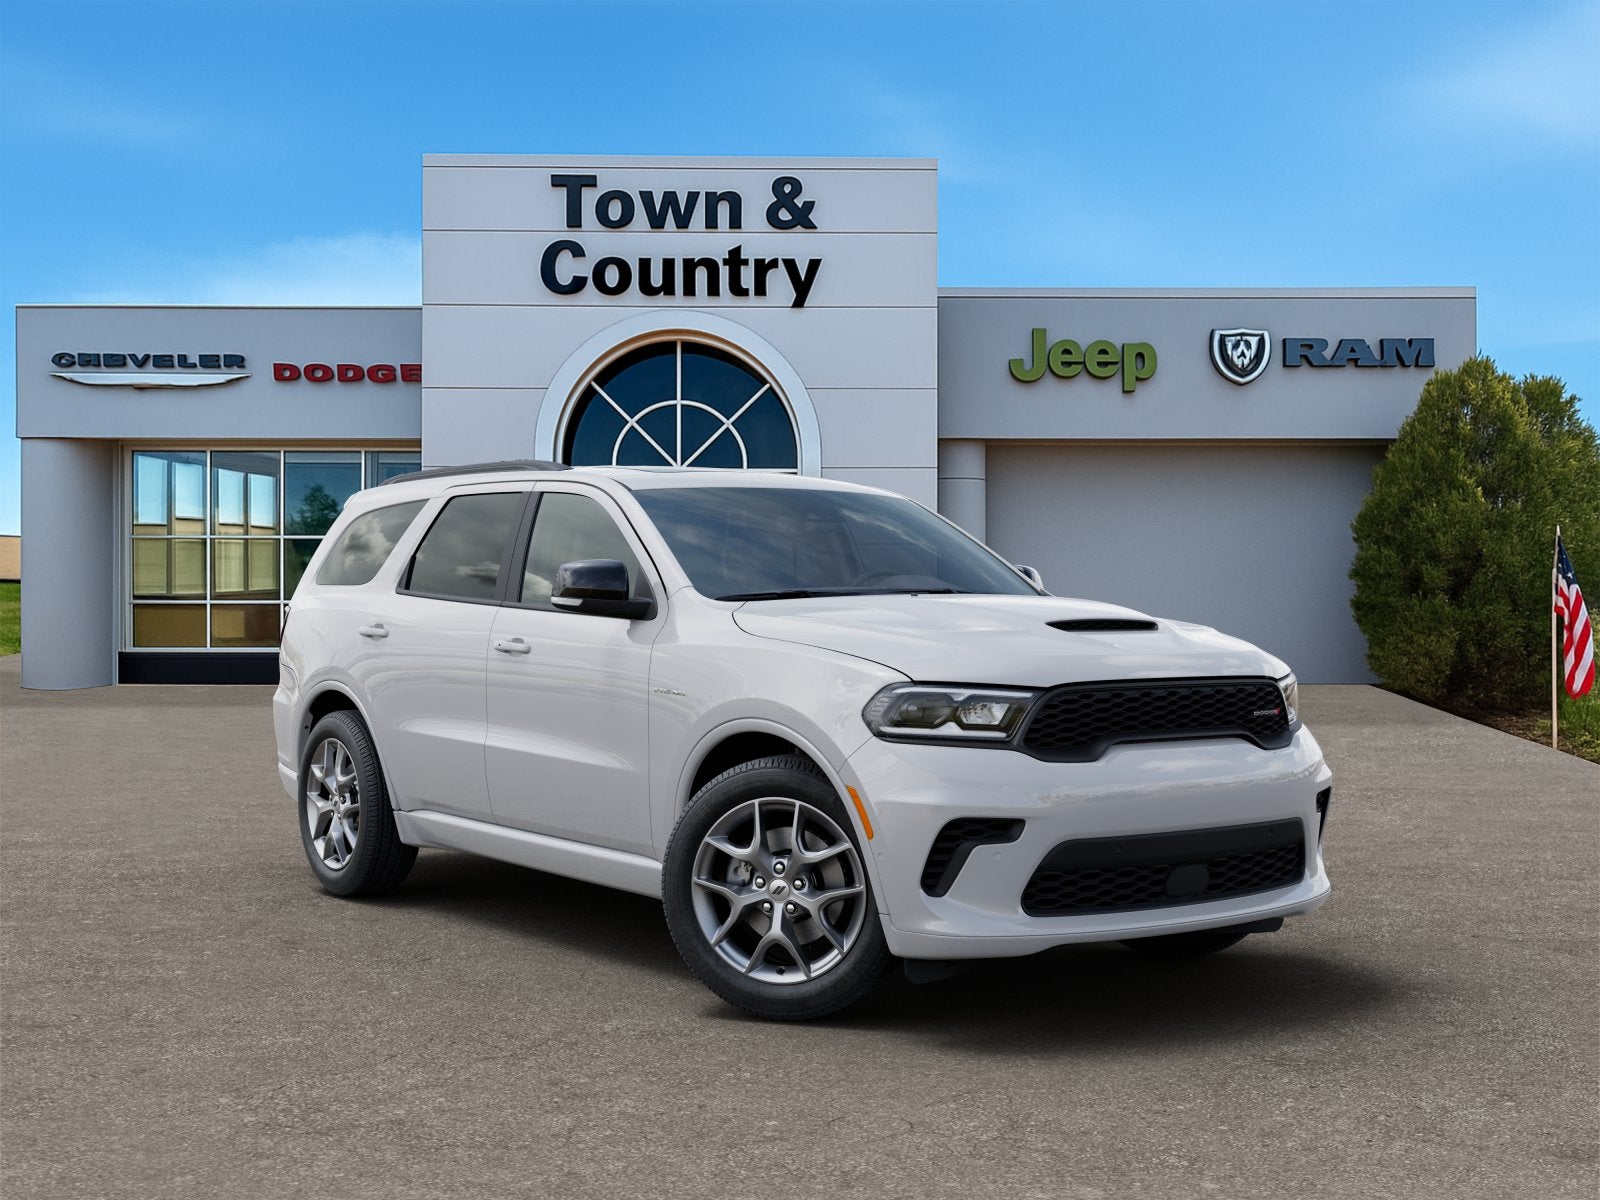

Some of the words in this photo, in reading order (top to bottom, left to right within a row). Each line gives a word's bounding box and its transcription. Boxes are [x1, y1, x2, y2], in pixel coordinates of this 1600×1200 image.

[550, 174, 743, 230] Town
[765, 175, 818, 231] &
[540, 239, 823, 308] Country
[273, 362, 422, 383] DODGE
[1009, 328, 1158, 393] Jeep
[1282, 337, 1435, 368] RAM
